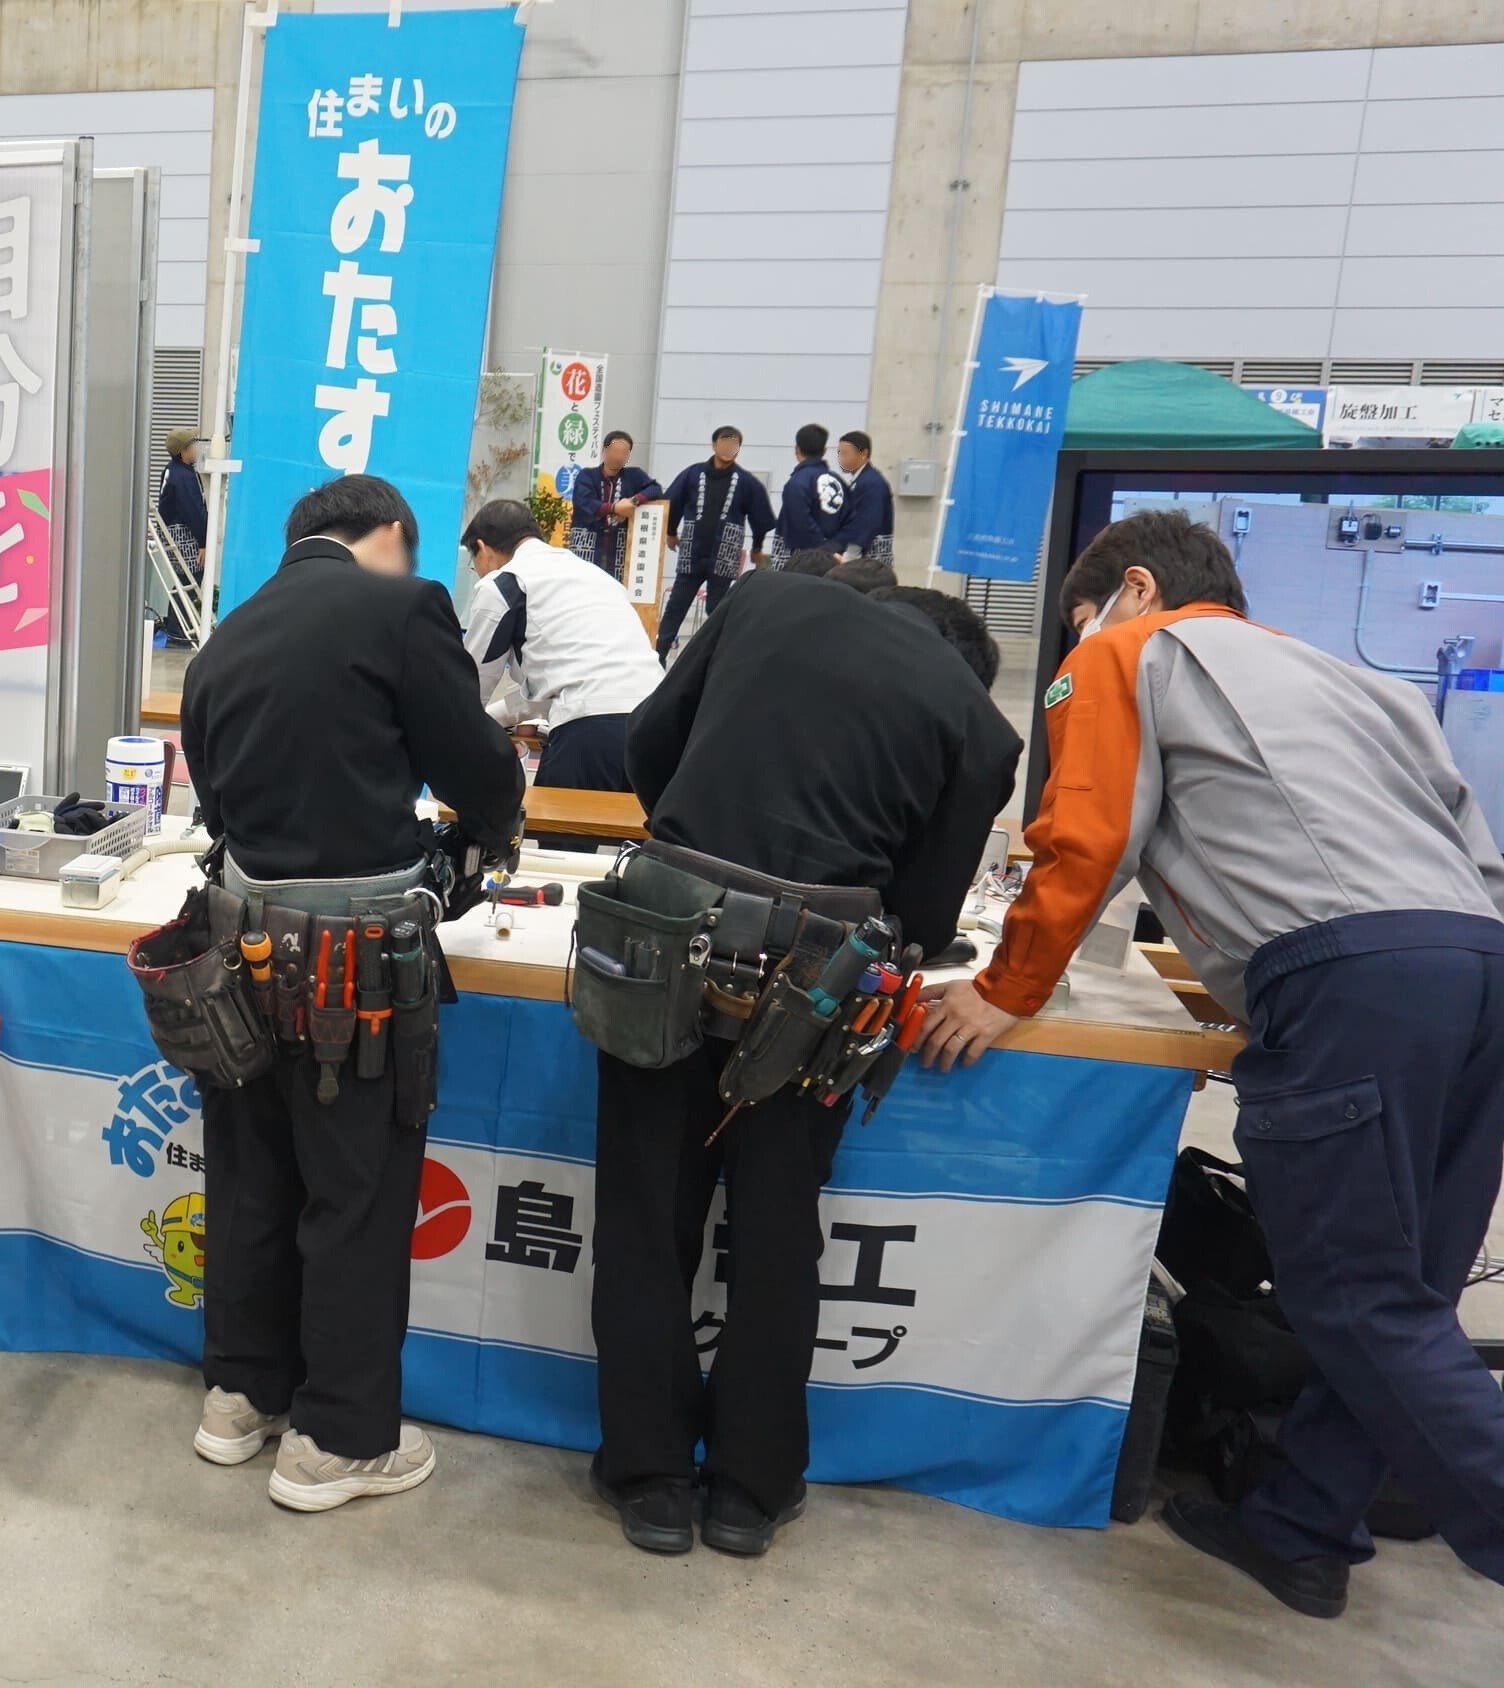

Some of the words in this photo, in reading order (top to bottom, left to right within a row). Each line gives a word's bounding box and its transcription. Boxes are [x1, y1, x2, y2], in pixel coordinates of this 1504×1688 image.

[307, 73, 456, 139] 住まいの
[979, 400, 1054, 420] SHIMANE
[1339, 403, 1417, 421] 旋盤加工
[977, 414, 1051, 434] TEKKOKAI
